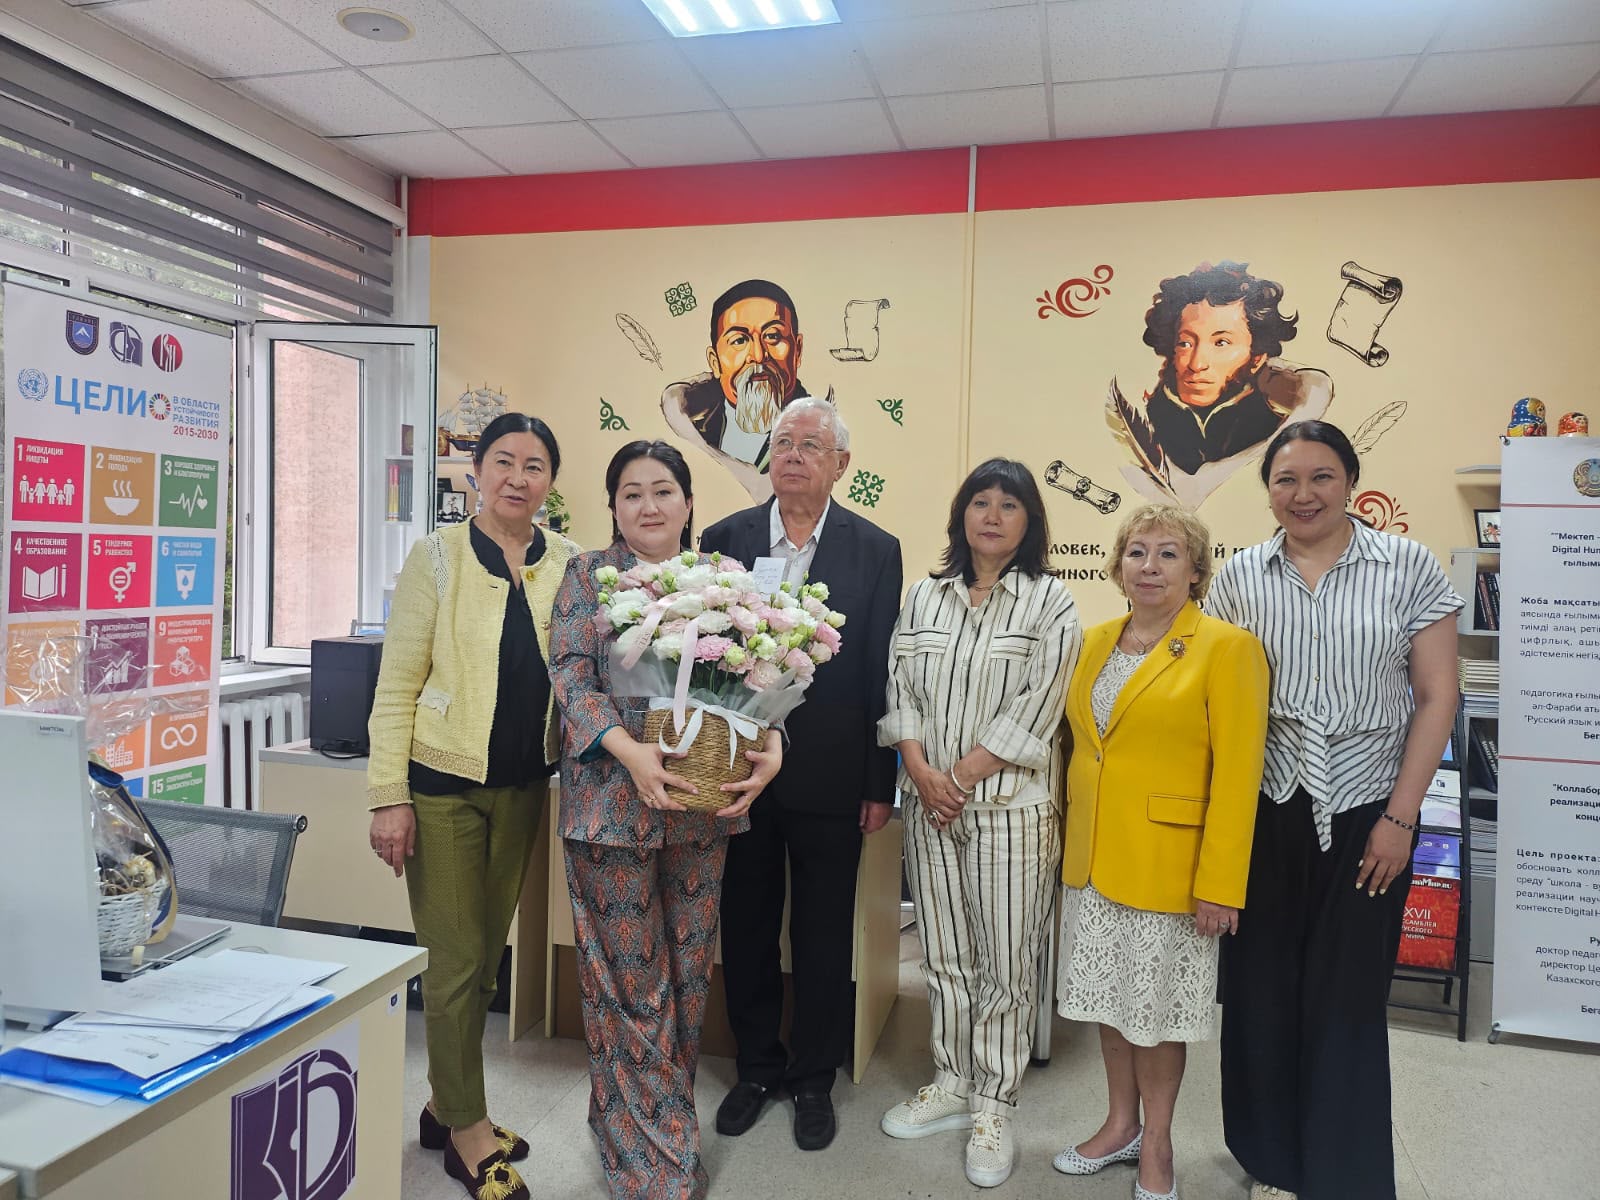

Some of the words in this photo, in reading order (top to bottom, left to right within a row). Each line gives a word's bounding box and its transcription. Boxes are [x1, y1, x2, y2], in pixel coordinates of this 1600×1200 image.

[54, 375, 147, 418] ЦЕЛИ
[173, 396, 179, 404] В
[180, 397, 220, 411] ОБЛАСТИ
[173, 405, 219, 419] УСТОЙЧИВОГО
[172, 413, 219, 428] РАЗВИТИЯ
[173, 425, 219, 440] 2015-2030
[17, 444, 23, 461] 1
[95, 452, 104, 469] 2
[164, 460, 172, 476] 3
[14, 537, 22, 555] 4
[26, 547, 67, 555] ОБРАЗОВАНИЕ
[93, 539, 102, 556] 5
[161, 541, 169, 557] 6
[1552, 545, 1581, 554] Digital
[1520, 597, 1549, 605] Жоба
[1520, 611, 1561, 620] аясында
[158, 621, 167, 636] 9
[1520, 624, 1549, 633] тиімді
[1576, 651, 1600, 660] негіз
[1520, 689, 1573, 699] педагогика
[152, 779, 164, 794] 15
[1575, 814, 1600, 823] конц
[1516, 848, 1545, 858] Цель
[1516, 862, 1572, 874] обосновать
[1516, 876, 1543, 886] среду
[1516, 890, 1574, 902] реализации
[1515, 904, 1563, 914] контексте
[1564, 906, 1594, 917] Digital
[1535, 946, 1570, 957] доктор
[1540, 961, 1586, 972] директор
[1546, 973, 1600, 987] Казахского
